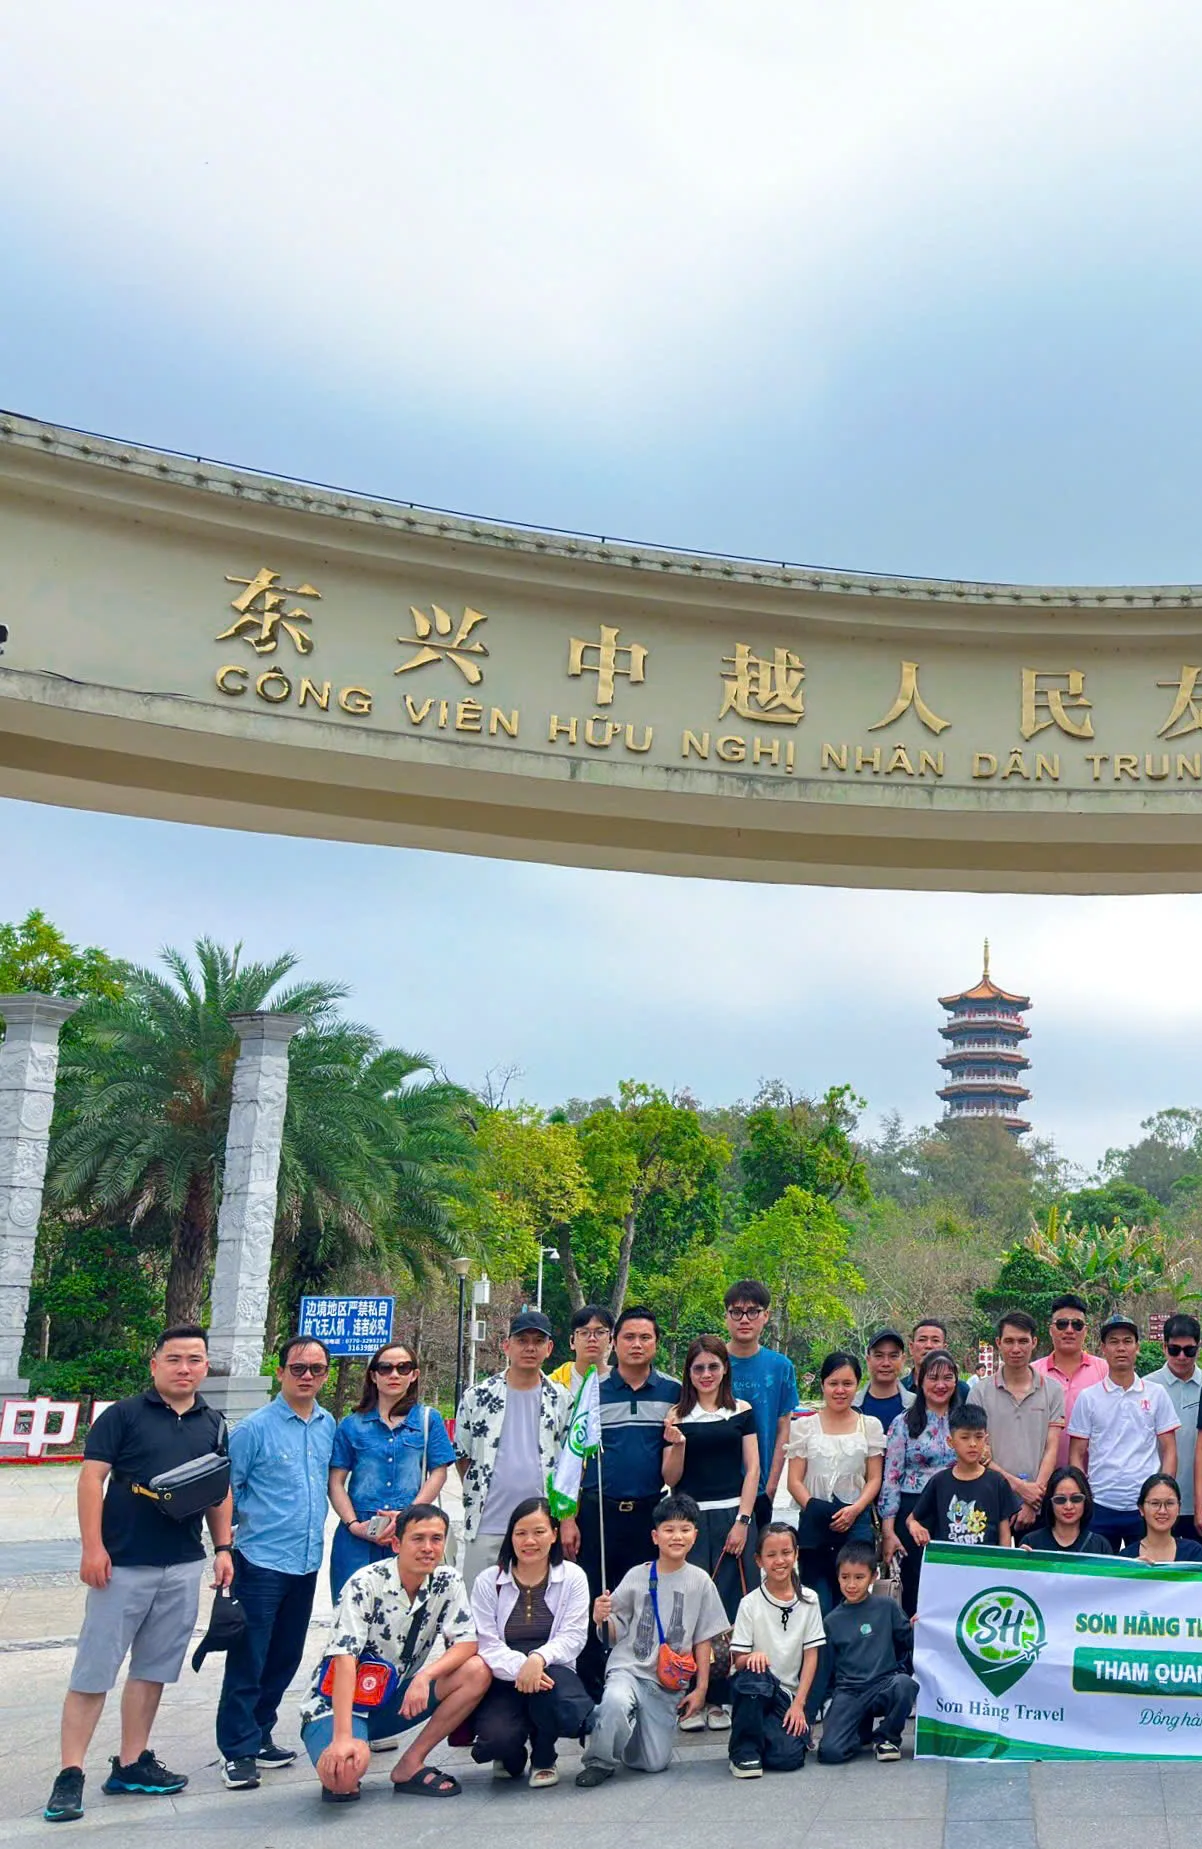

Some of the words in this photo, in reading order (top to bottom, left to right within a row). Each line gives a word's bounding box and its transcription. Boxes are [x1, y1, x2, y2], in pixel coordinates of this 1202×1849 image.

[215, 664, 373, 716] CÔNG
[404, 695, 519, 738] VIÊN
[548, 714, 653, 752] HỮU
[682, 730, 796, 775] NGHỊ
[821, 742, 944, 777] NHÂN
[972, 747, 1060, 782] DÂN
[305, 1300, 388, 1317] 边境地区严禁私自
[974, 1606, 1025, 1646] SH
[1075, 1612, 1117, 1635] SƠN
[1093, 1660, 1149, 1682] THAM
[936, 1697, 963, 1714] Sơn
[1015, 1704, 1065, 1722] Travel
[1139, 1708, 1180, 1732] Đồng
